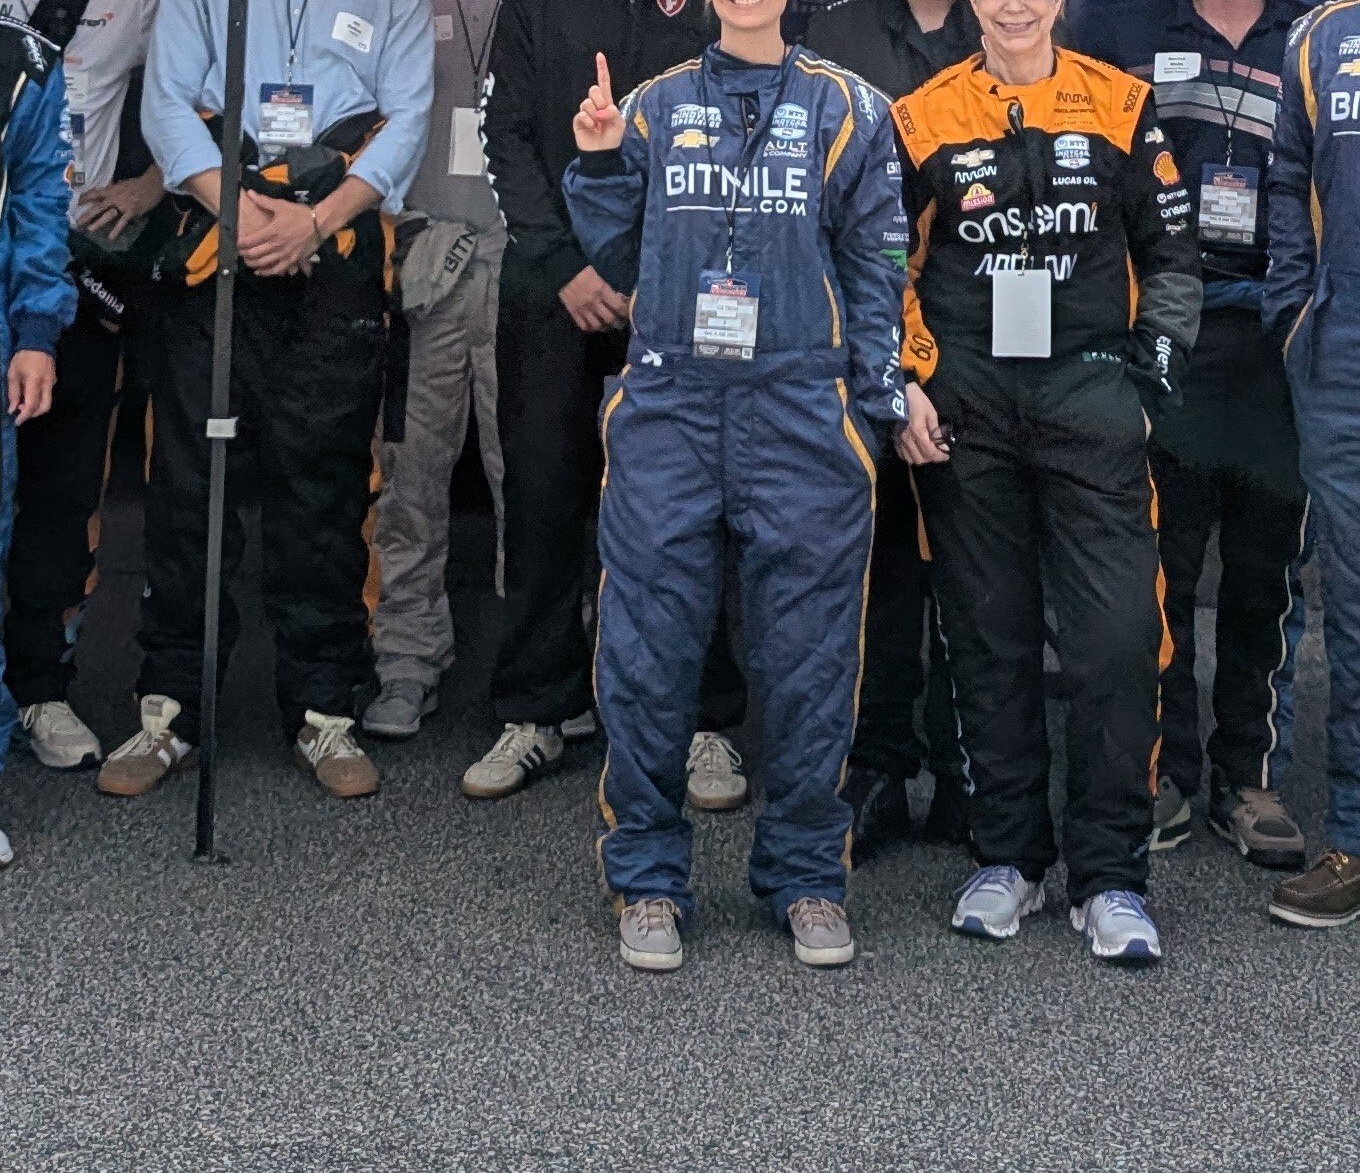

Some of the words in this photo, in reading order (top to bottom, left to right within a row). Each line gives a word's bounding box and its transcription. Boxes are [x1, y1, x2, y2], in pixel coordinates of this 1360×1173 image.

[1123, 82, 1144, 114] sparco
[896, 103, 916, 137] sparco
[765, 140, 808, 152] AULT
[665, 163, 808, 200] BITNILE
[1052, 176, 1082, 186] LUCAS
